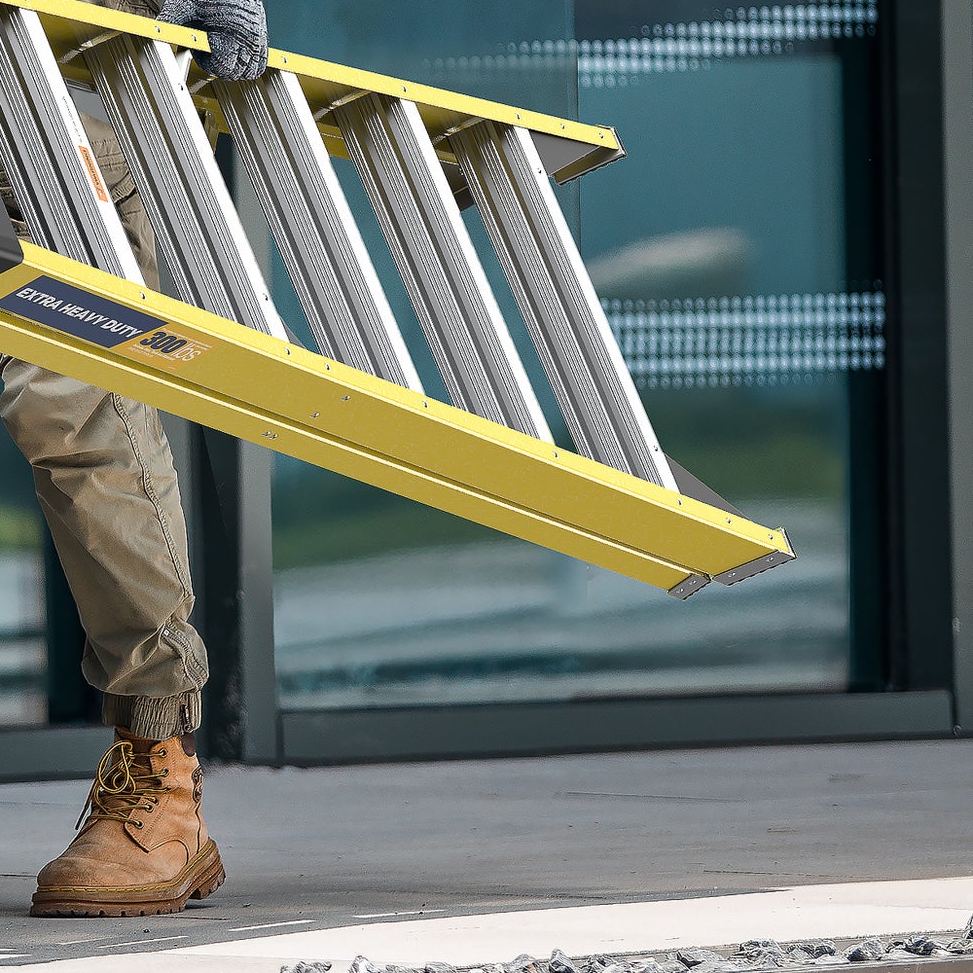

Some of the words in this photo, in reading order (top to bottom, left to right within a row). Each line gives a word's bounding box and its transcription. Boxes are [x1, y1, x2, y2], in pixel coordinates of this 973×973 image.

[16, 287, 64, 310] EXTRA
[58, 303, 108, 325] HEAVY
[100, 319, 143, 338] DUTY
